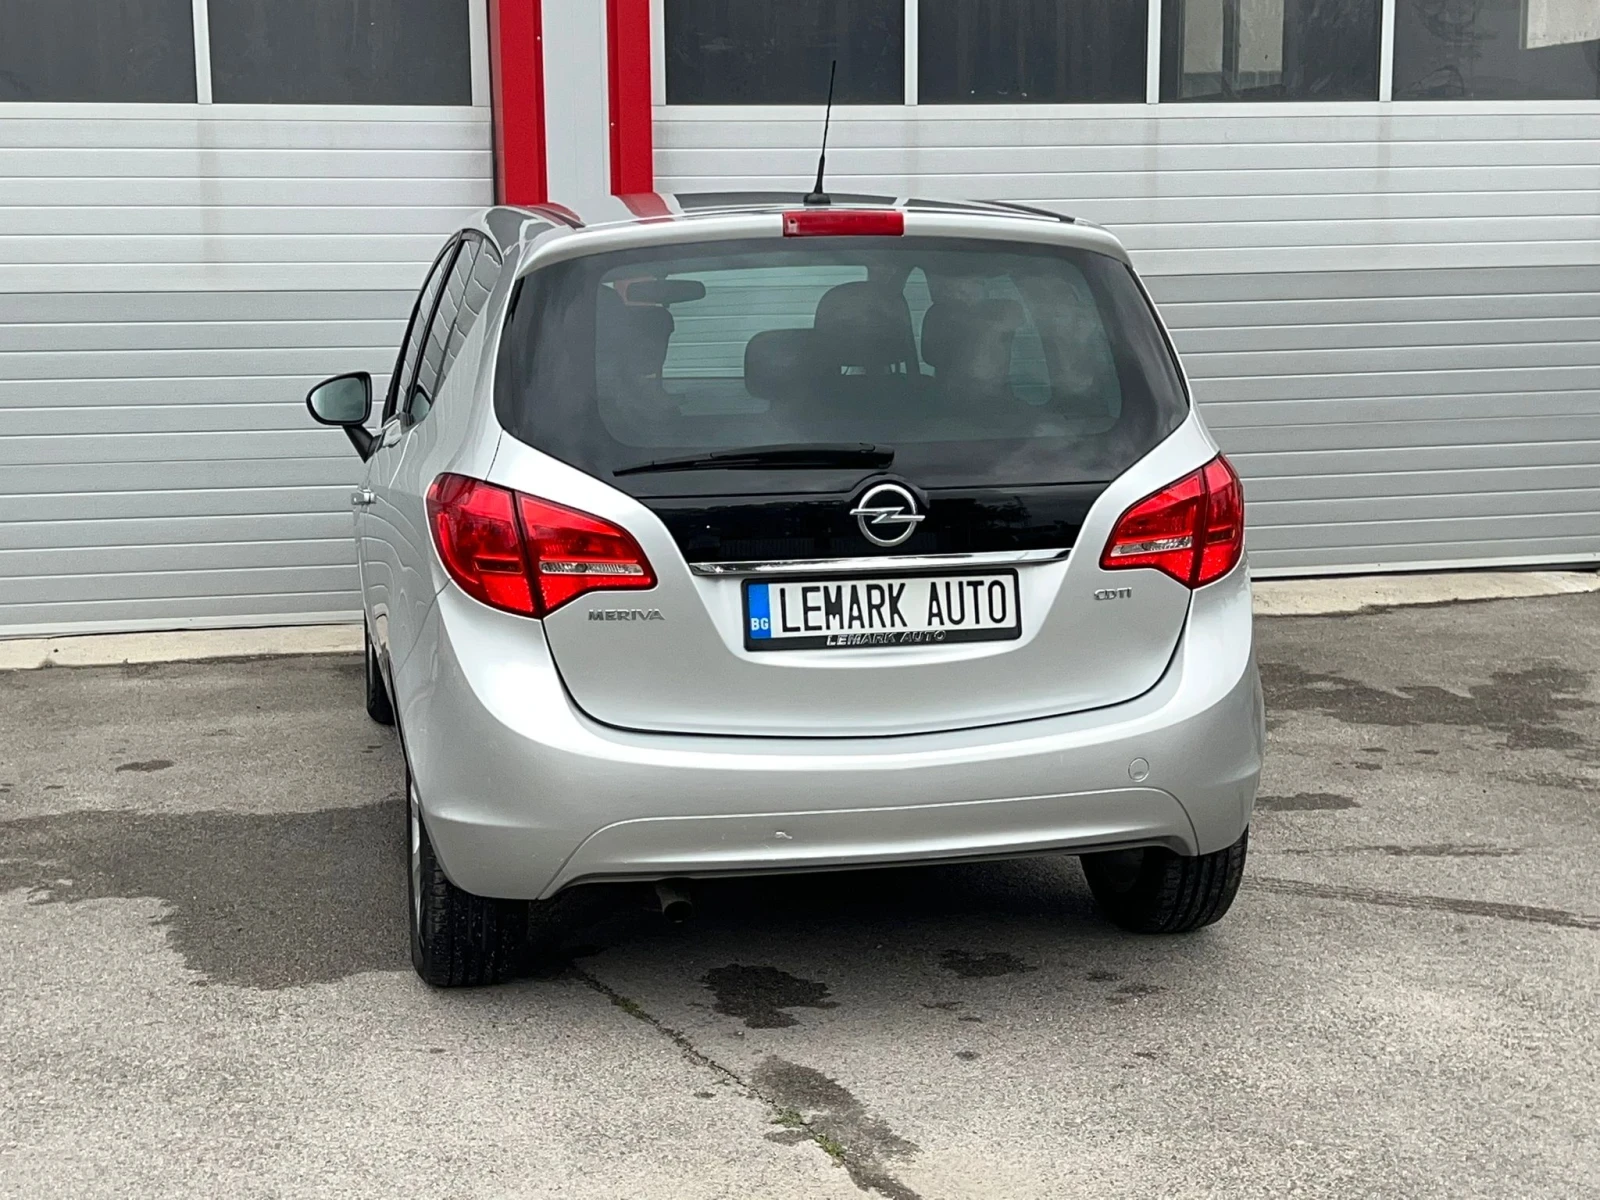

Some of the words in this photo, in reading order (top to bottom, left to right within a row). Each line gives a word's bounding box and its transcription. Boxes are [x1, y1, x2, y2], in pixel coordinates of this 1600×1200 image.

[780, 582, 908, 633] LEMARK
[927, 579, 1007, 627] AUTO
[588, 609, 665, 621] MERIVA
[750, 617, 769, 631] BG
[826, 632, 897, 646] LEMARK
[900, 630, 947, 643] AUTO
